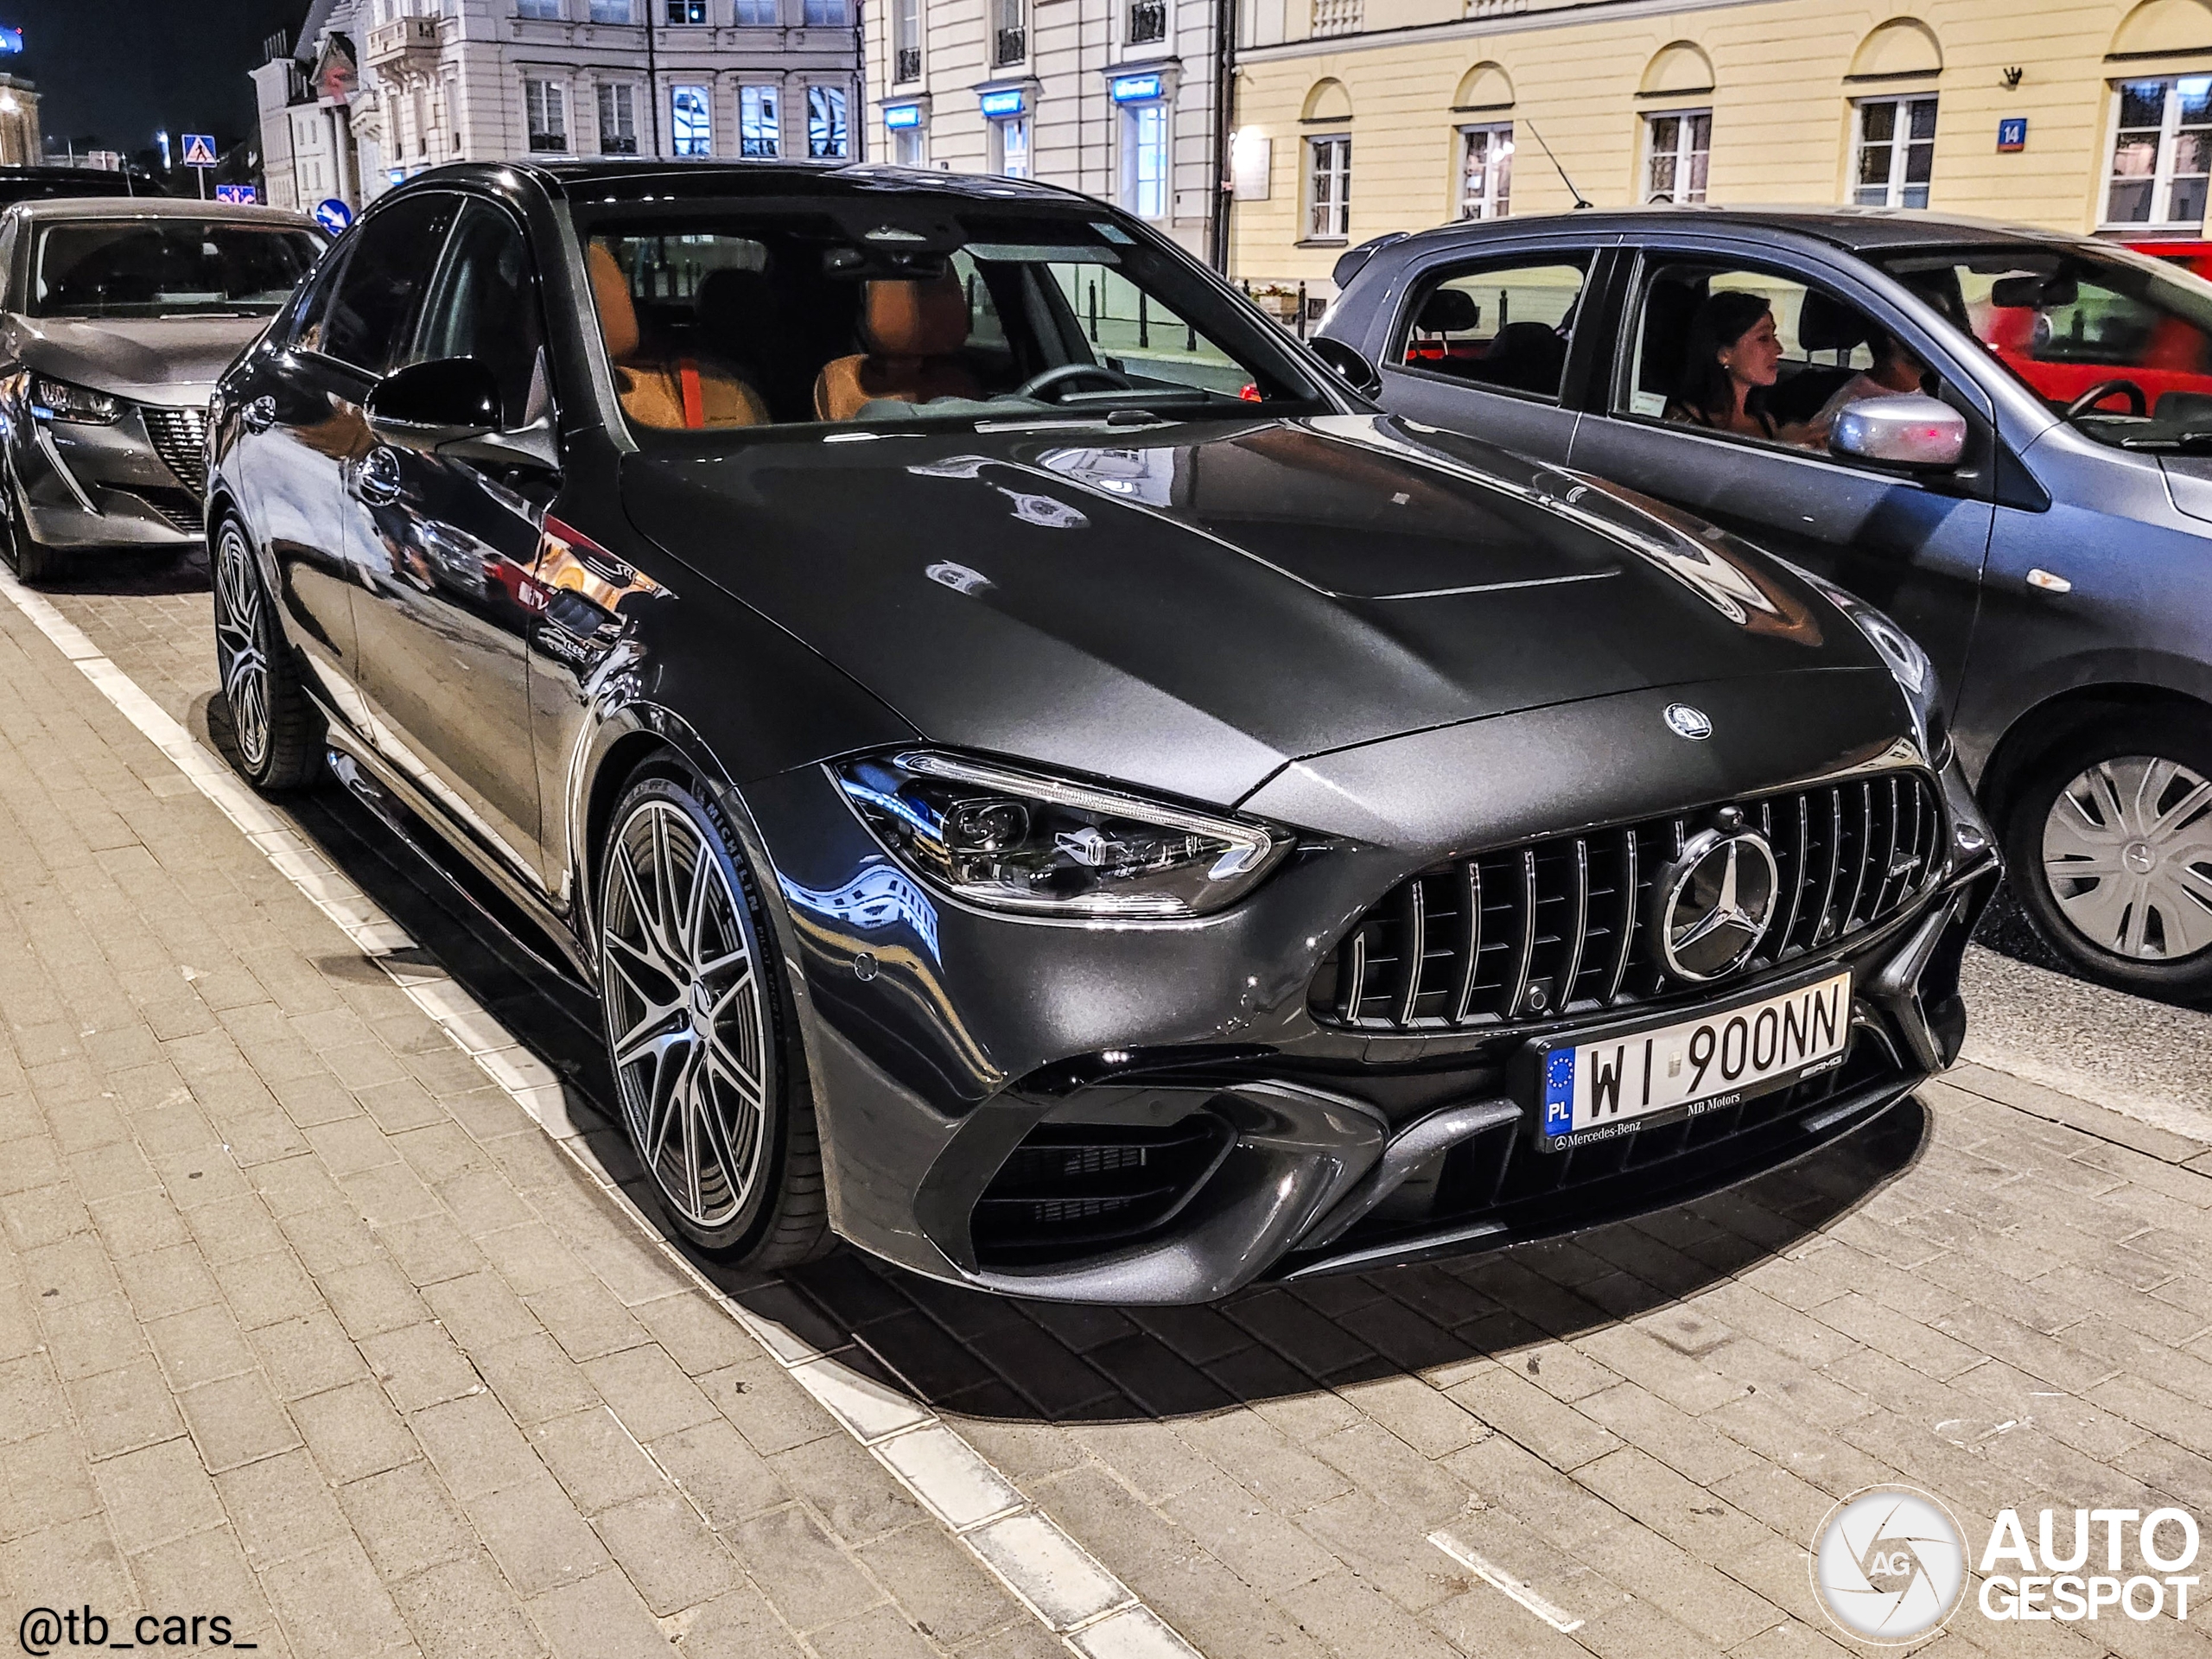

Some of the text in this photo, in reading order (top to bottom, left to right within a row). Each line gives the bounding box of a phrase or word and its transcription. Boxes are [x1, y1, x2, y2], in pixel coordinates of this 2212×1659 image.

[2004, 125, 2019, 143] 14
[706, 802, 760, 912] MICHELIN
[1687, 983, 1839, 1095] 900NN
[1548, 1103, 1570, 1122] PL
[1687, 1092, 1741, 1117] MB Motors
[1567, 1121, 1642, 1147] Mercedes-Benz
